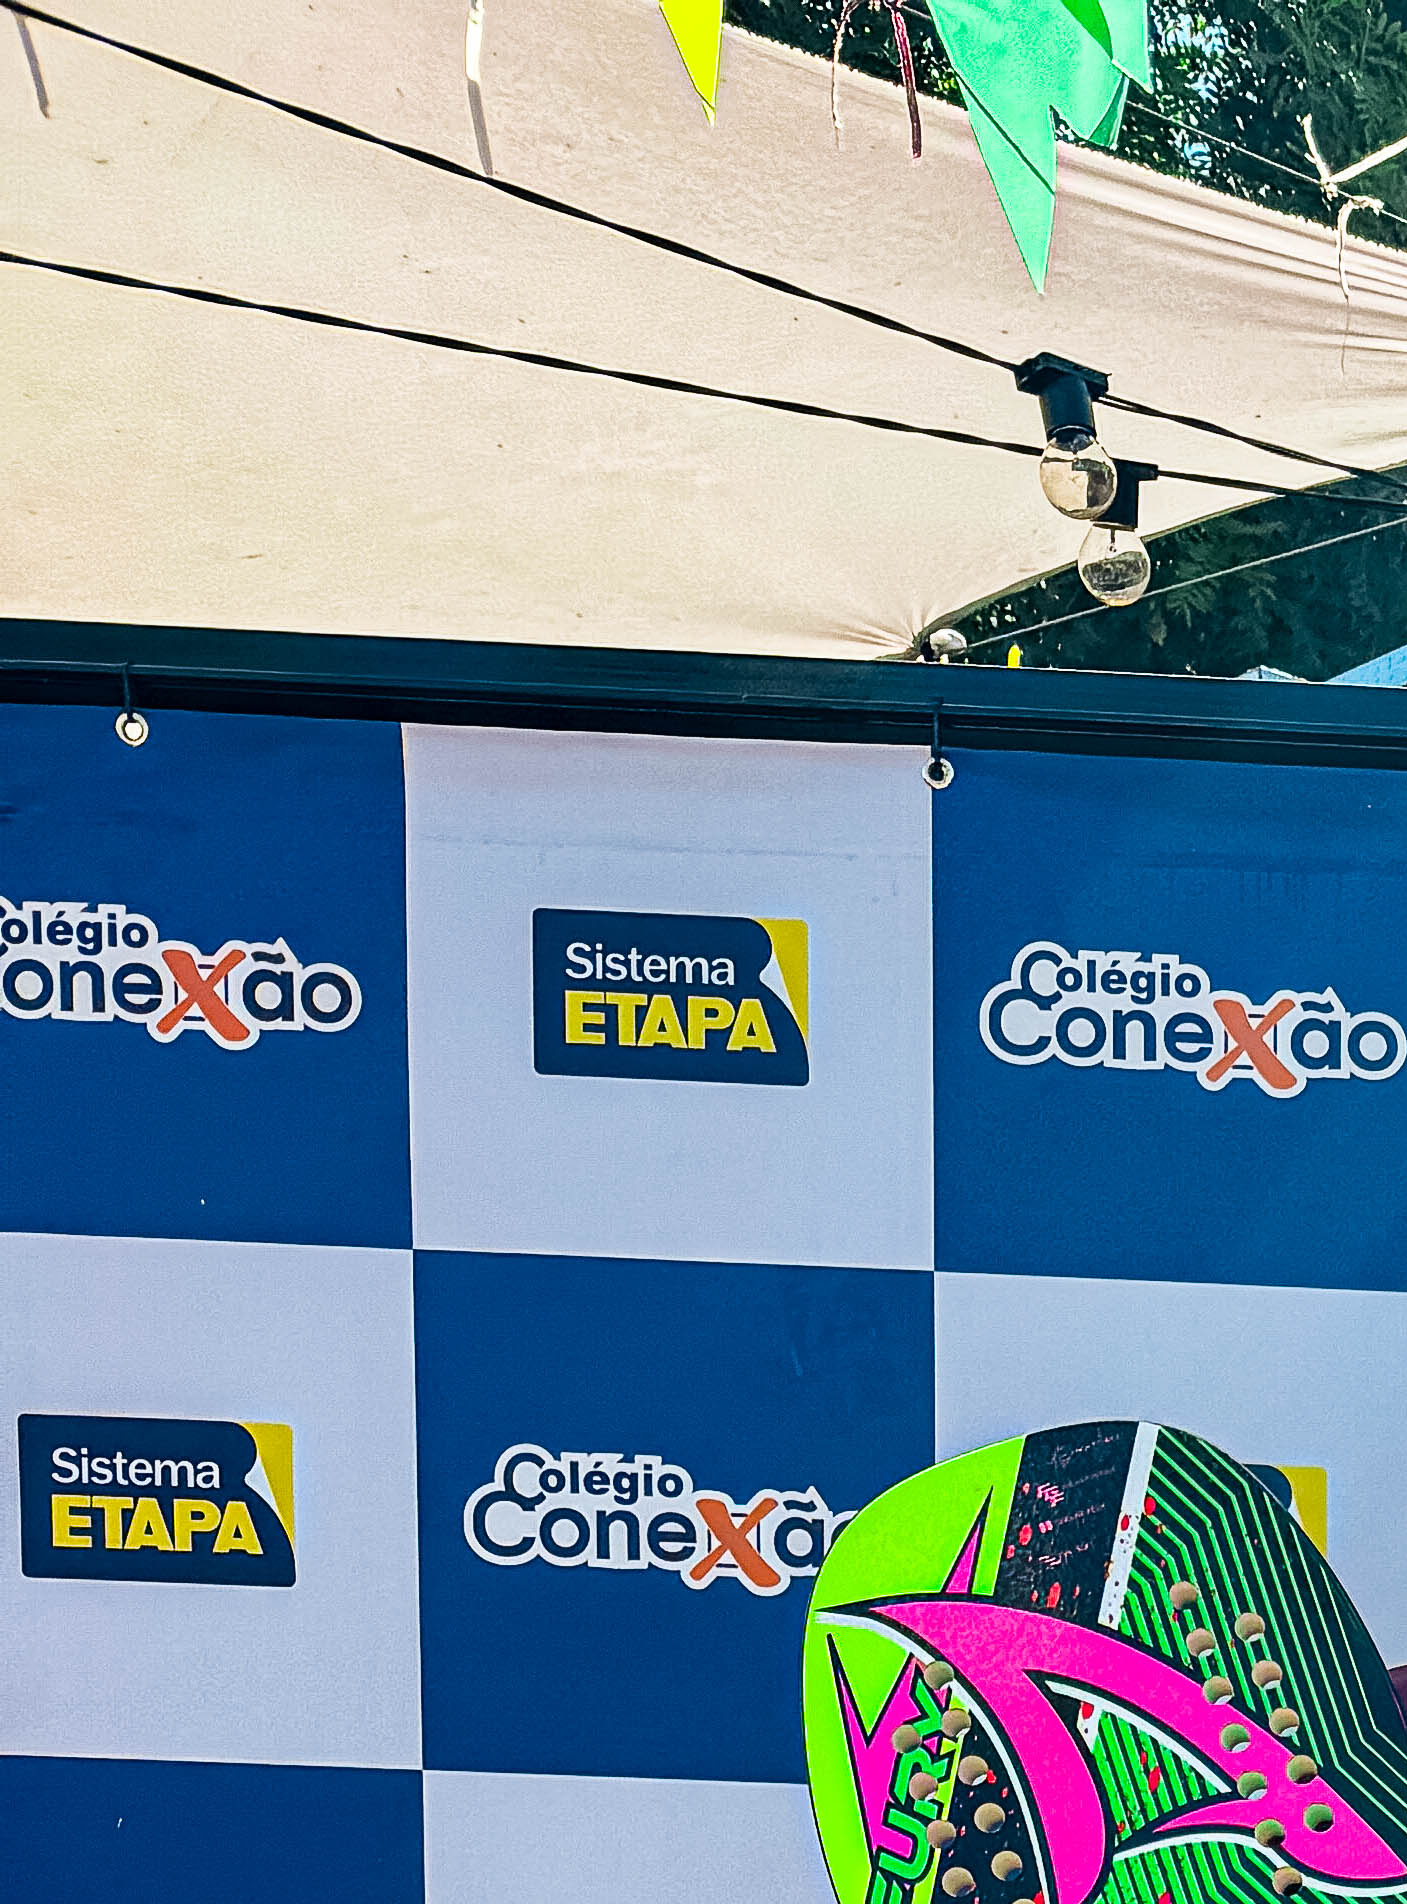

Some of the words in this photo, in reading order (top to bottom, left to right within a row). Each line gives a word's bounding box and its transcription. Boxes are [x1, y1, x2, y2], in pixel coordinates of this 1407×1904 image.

[0, 910, 150, 957] olégio
[0, 937, 355, 1046] oneXão
[565, 941, 735, 988] Sistema
[1017, 945, 1204, 1002] Colégio
[565, 993, 778, 1053] ETAPA
[52, 1447, 220, 1489] Sistema
[505, 1449, 686, 1503] Colégio
[52, 1497, 264, 1556] ETAPA
[472, 1487, 830, 1590] ConeXã
